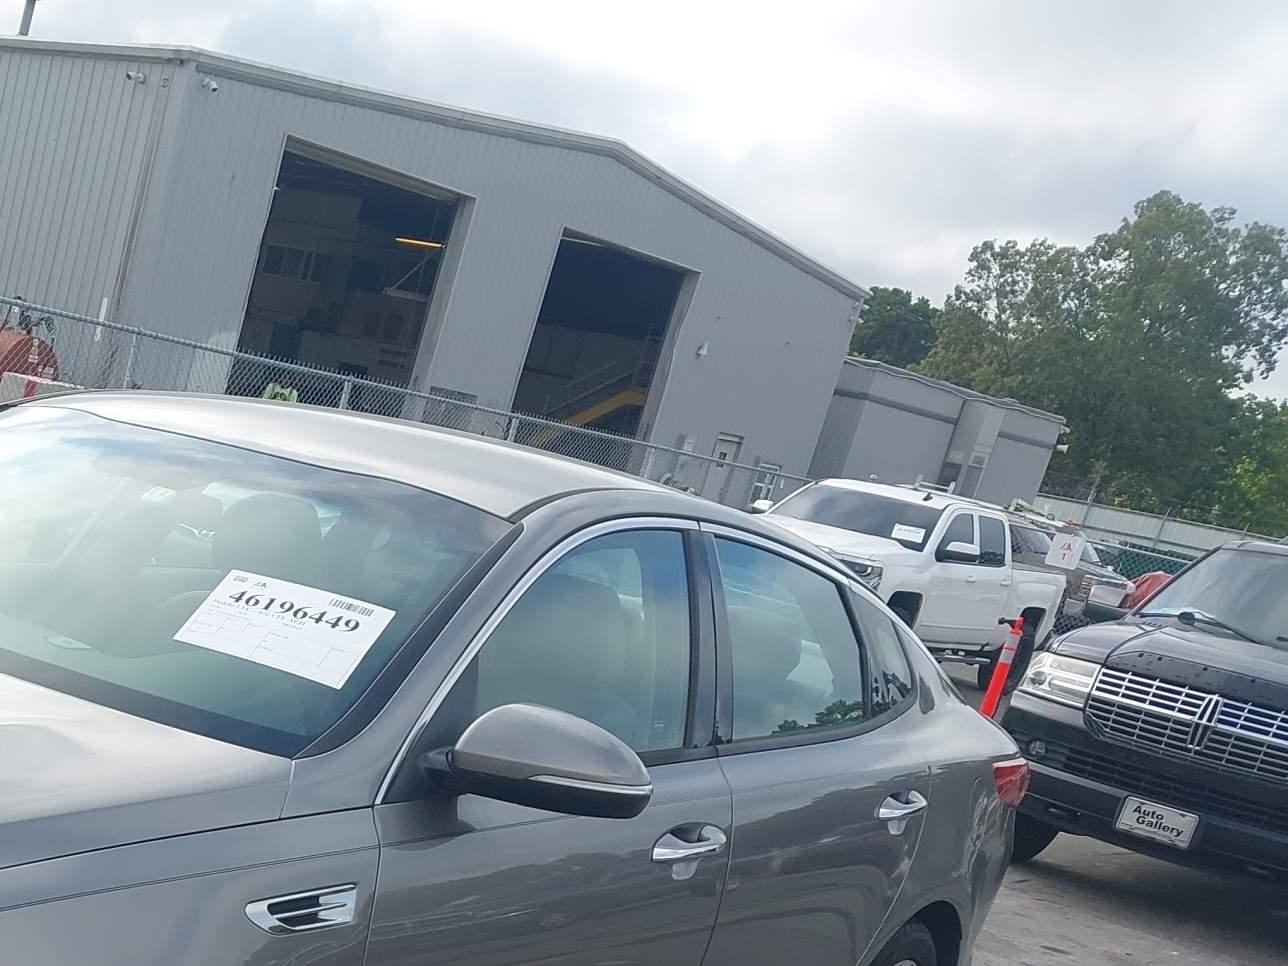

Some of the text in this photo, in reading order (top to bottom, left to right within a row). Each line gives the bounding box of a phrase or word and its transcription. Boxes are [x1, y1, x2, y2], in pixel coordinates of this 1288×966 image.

[228, 590, 360, 632] 46196449
[1132, 805, 1164, 820] Auto
[1136, 815, 1184, 837] Gallery
